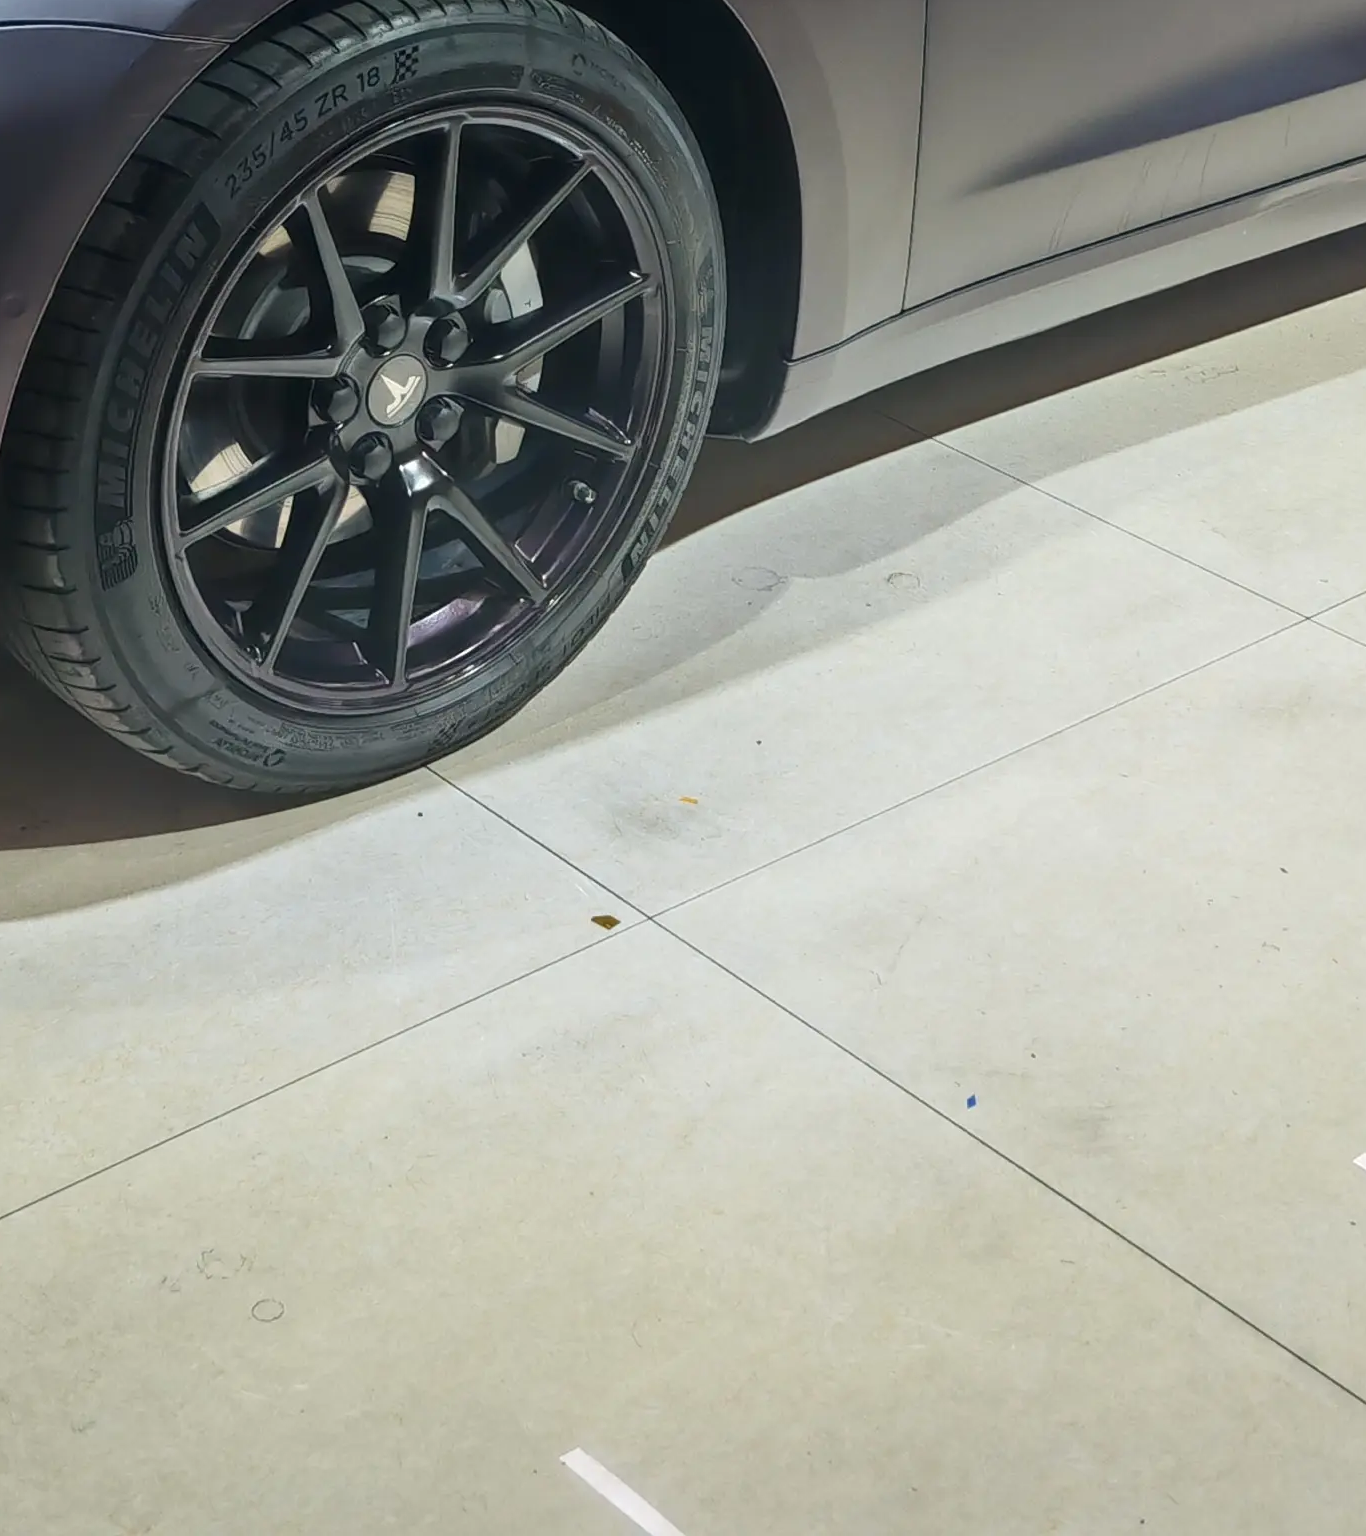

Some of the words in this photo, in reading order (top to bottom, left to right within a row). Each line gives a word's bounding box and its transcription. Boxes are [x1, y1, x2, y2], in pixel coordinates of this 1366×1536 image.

[224, 108, 310, 200] 235/45
[313, 83, 350, 119] ZR
[355, 66, 382, 93] 18
[98, 220, 211, 509] MICHELIN
